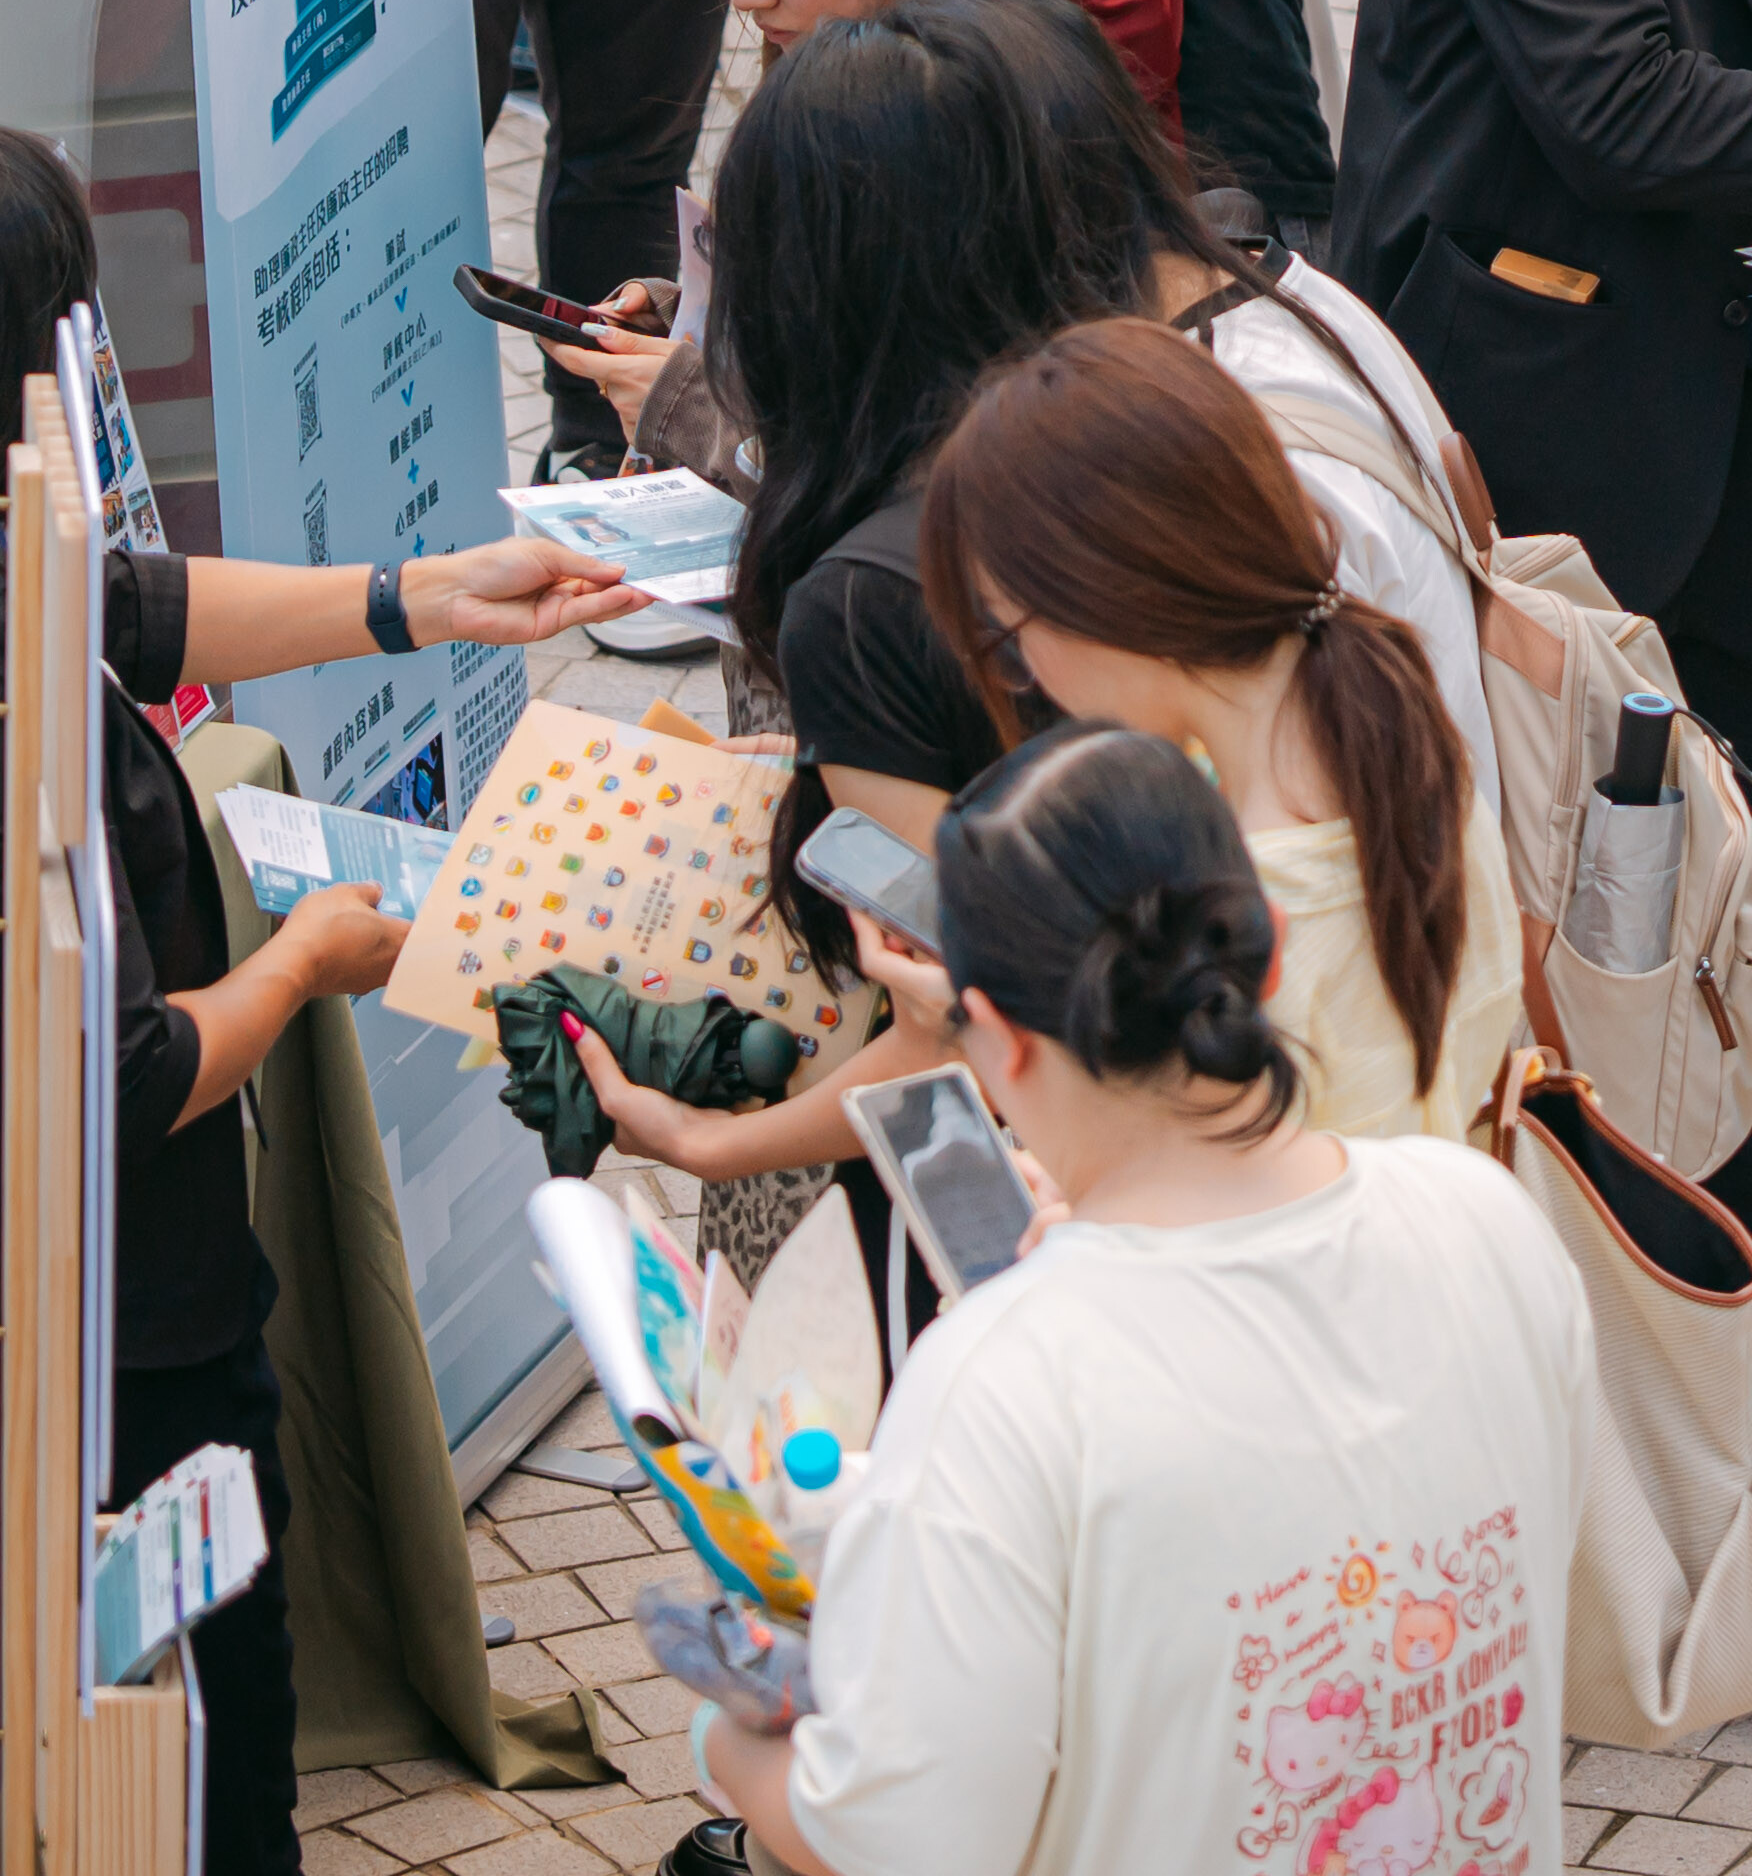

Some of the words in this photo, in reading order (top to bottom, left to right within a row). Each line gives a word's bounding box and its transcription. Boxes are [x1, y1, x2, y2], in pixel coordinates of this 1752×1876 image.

[254, 125, 410, 300] 助理廉政主任及廉政主任的招聘
[385, 228, 407, 267] 筆試
[382, 311, 427, 371] 評核中心
[389, 403, 434, 465] 體能測試
[395, 479, 440, 538] 心理測驗
[321, 681, 395, 782] 課程內容涵蓋
